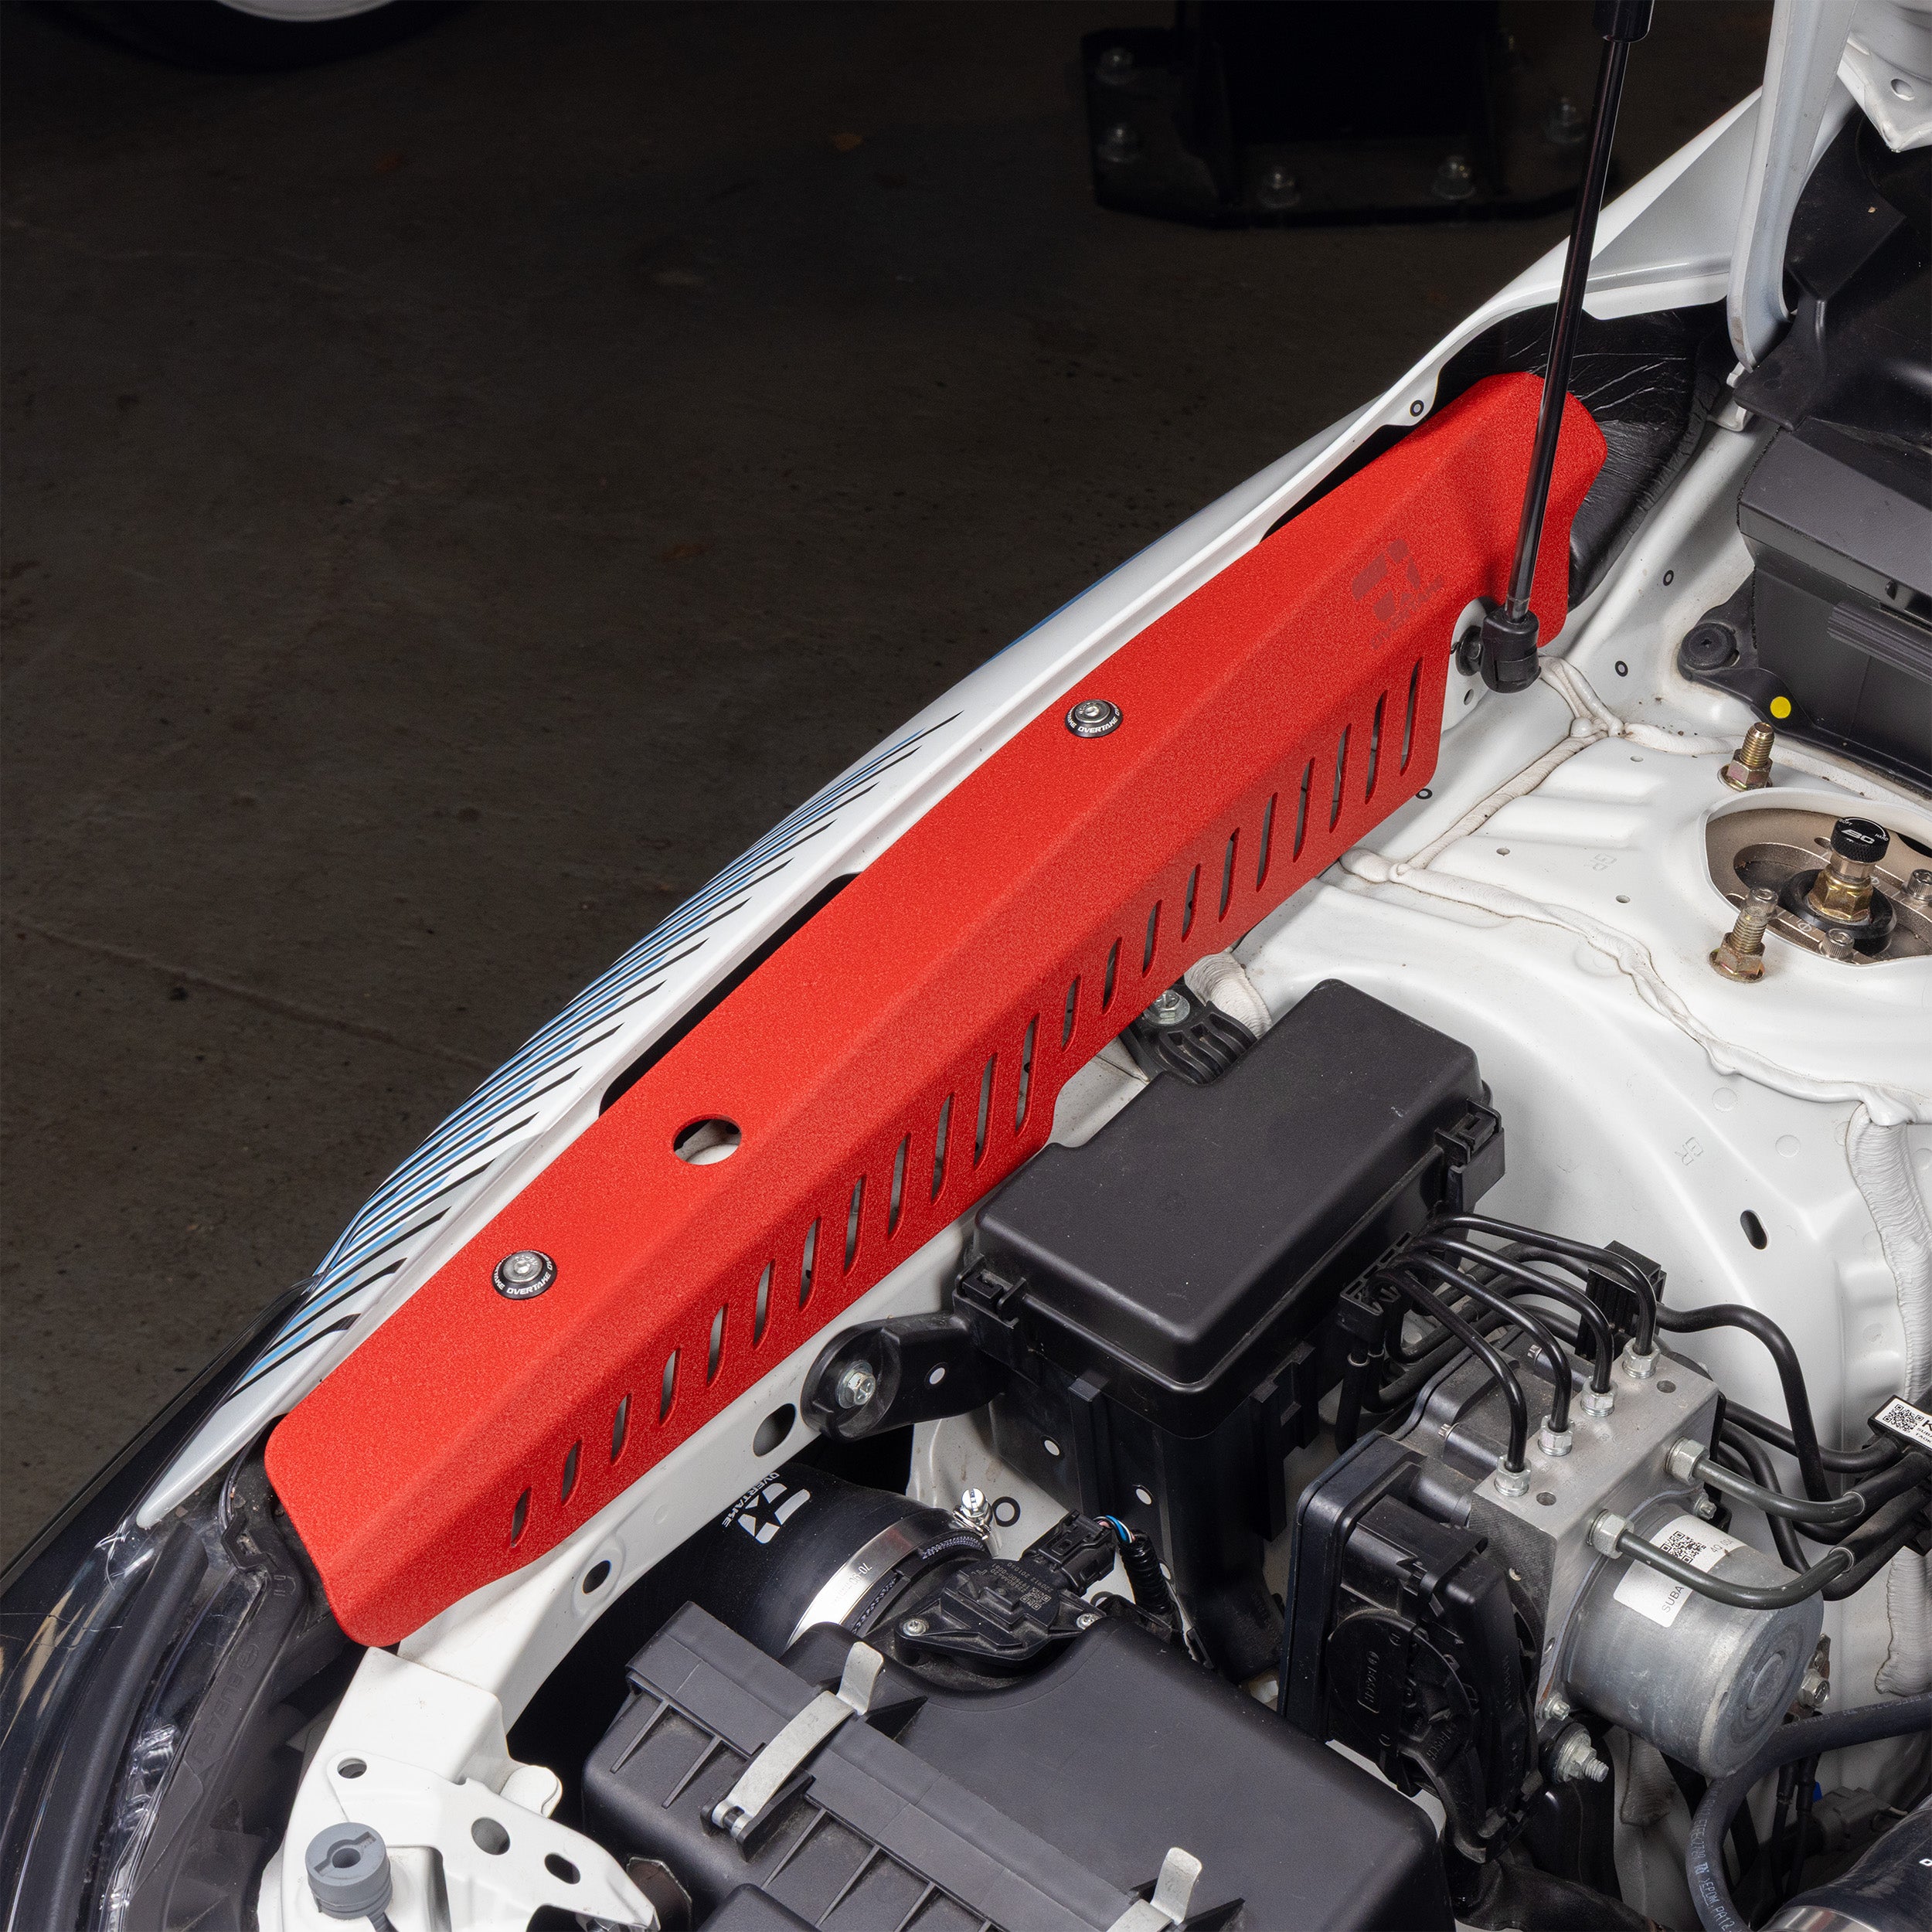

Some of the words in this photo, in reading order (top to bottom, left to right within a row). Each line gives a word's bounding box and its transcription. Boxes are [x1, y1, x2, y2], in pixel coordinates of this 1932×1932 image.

[1077, 716, 1118, 733] OVERTAKE
[1874, 833, 1889, 842] HARD
[506, 1271, 552, 1295] OVERTAKE
[722, 1471, 781, 1528] OVERTAKE
[1662, 1586, 1685, 1614] SUBA
